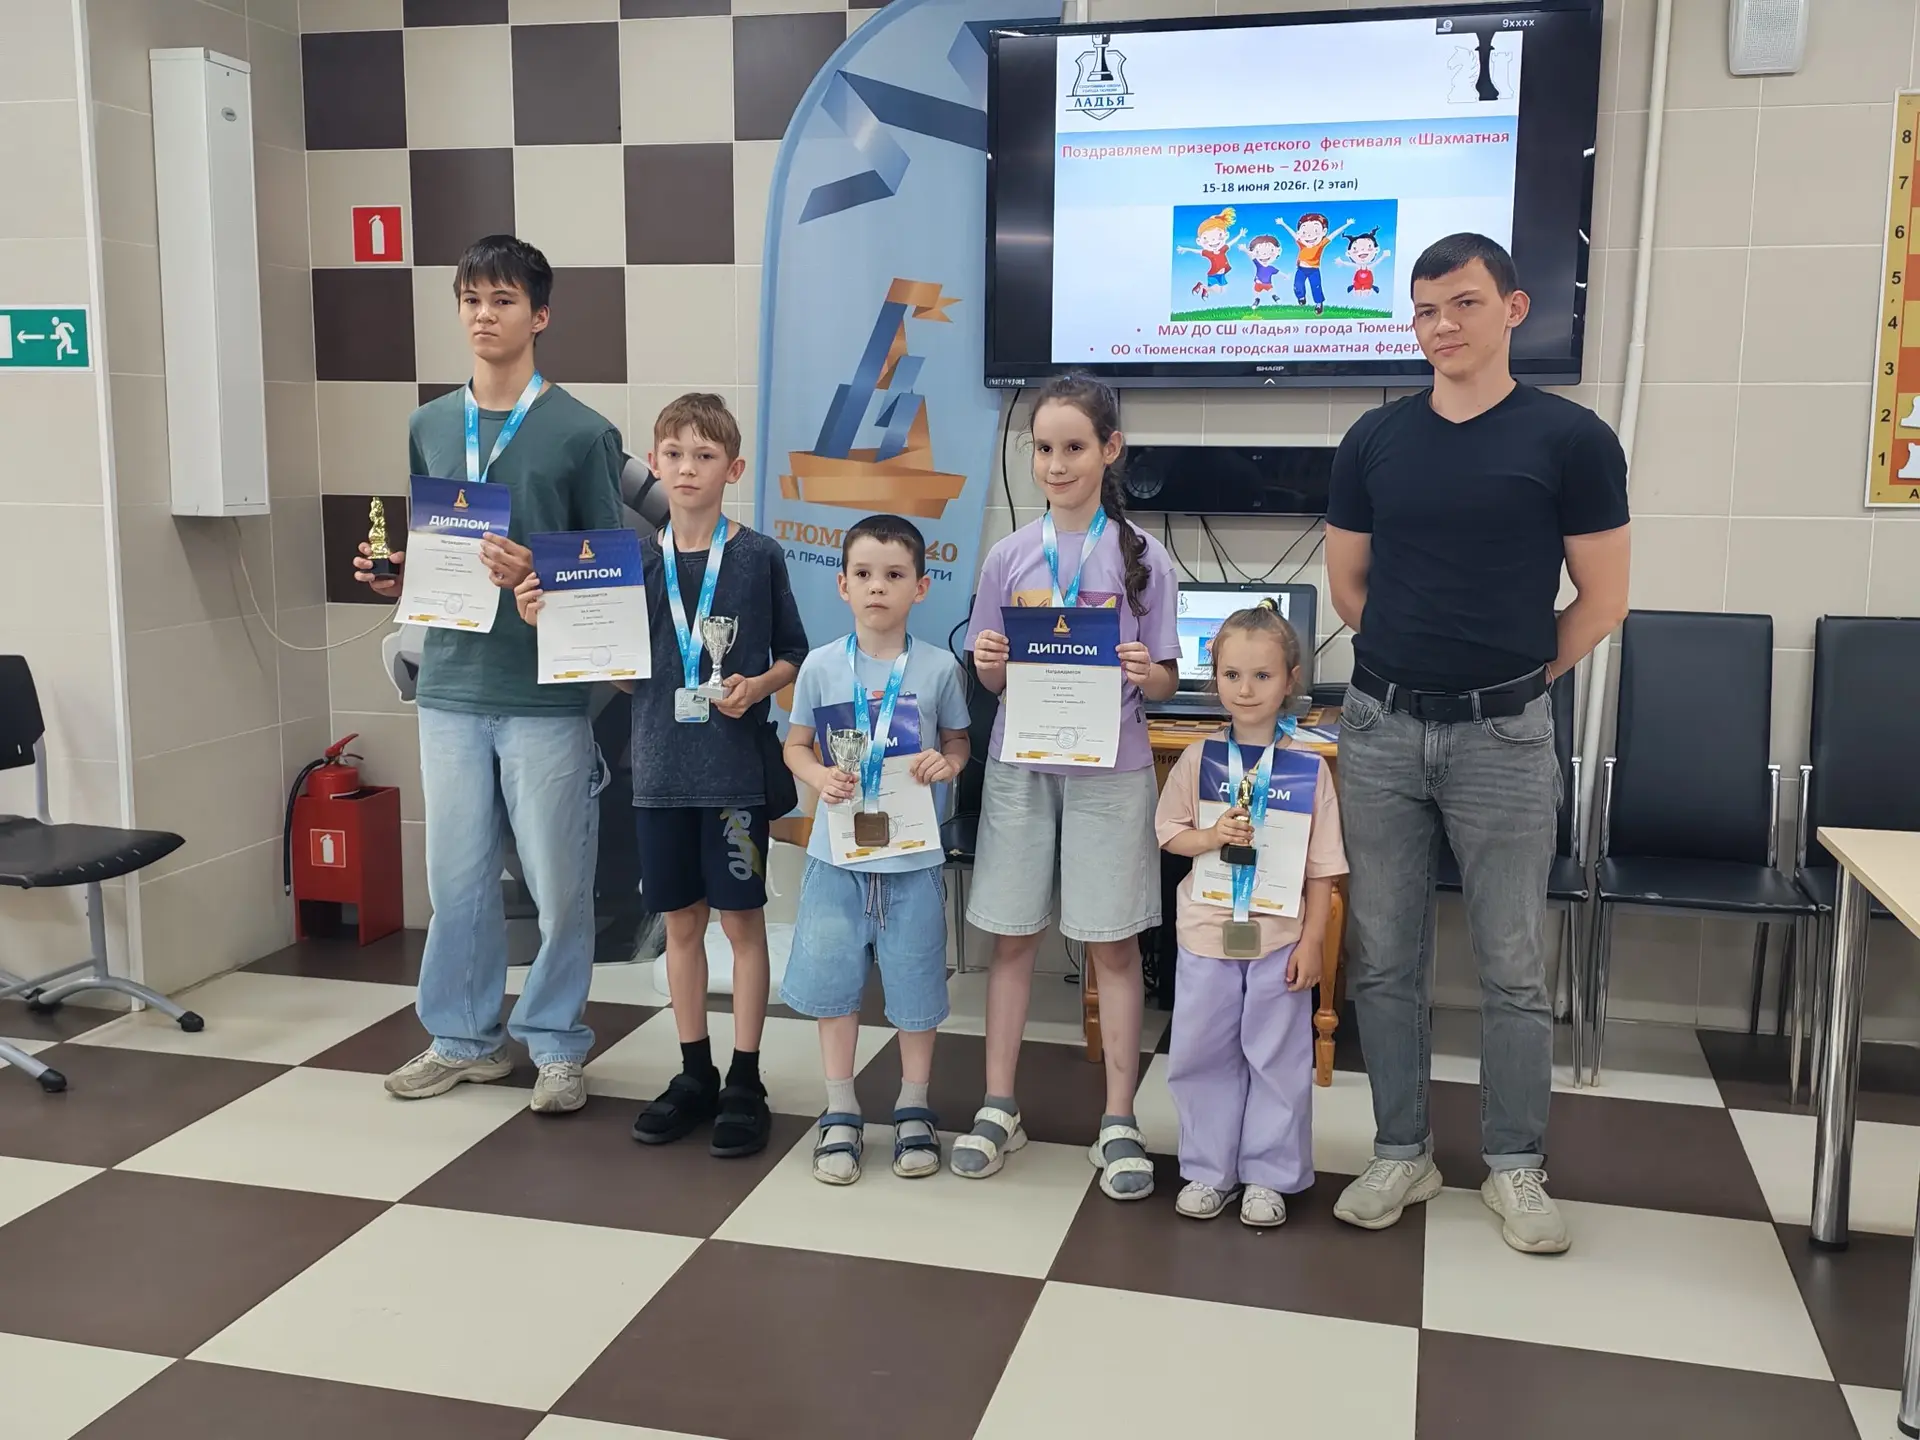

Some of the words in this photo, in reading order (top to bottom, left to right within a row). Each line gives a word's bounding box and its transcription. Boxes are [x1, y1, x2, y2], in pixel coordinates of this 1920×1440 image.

[1074, 96, 1125, 108] ЛАДЬЯ
[1902, 130, 1912, 144] 8
[1062, 145, 1162, 160] Поздравляем
[1168, 141, 1240, 157] призеров
[1243, 138, 1311, 155] детского
[1320, 135, 1402, 152] фестиваля
[1409, 131, 1510, 147] «Шахматная
[1214, 160, 1275, 175] Тюмень
[1202, 182, 1235, 193] 15-18
[1237, 182, 1270, 192] июня
[1273, 180, 1310, 192] 2026г.
[1313, 179, 1325, 191] (2
[1328, 178, 1359, 191] этап)
[1899, 176, 1909, 190] 7
[1895, 225, 1905, 239] 6
[1891, 271, 1901, 285] 5
[1158, 324, 1188, 336] МАУ
[1191, 324, 1211, 338] ДО
[1216, 323, 1237, 336] СШ
[1241, 323, 1299, 336] «Ладья»
[1304, 324, 1353, 337] города
[1356, 321, 1414, 334] Тюмени
[1887, 316, 1898, 330] 4
[1111, 344, 1131, 355] ОО
[1135, 343, 1216, 356] «Тюменская
[1221, 344, 1289, 357] городская
[1293, 342, 1369, 354] шахматная
[1375, 341, 1420, 355] федер
[1884, 362, 1895, 376] 3
[1881, 409, 1891, 423] 2
[1878, 452, 1886, 466] 1
[1909, 488, 1920, 499] A
[429, 514, 490, 531] ДИПЛОМ
[774, 519, 844, 549] ТЮМ
[925, 540, 958, 563] 40
[799, 550, 843, 568] ПРАВИ
[555, 567, 622, 583] ДИПЛОМ
[1027, 642, 1098, 656] ДИПЛОМ
[1218, 781, 1291, 801] ДОМ
